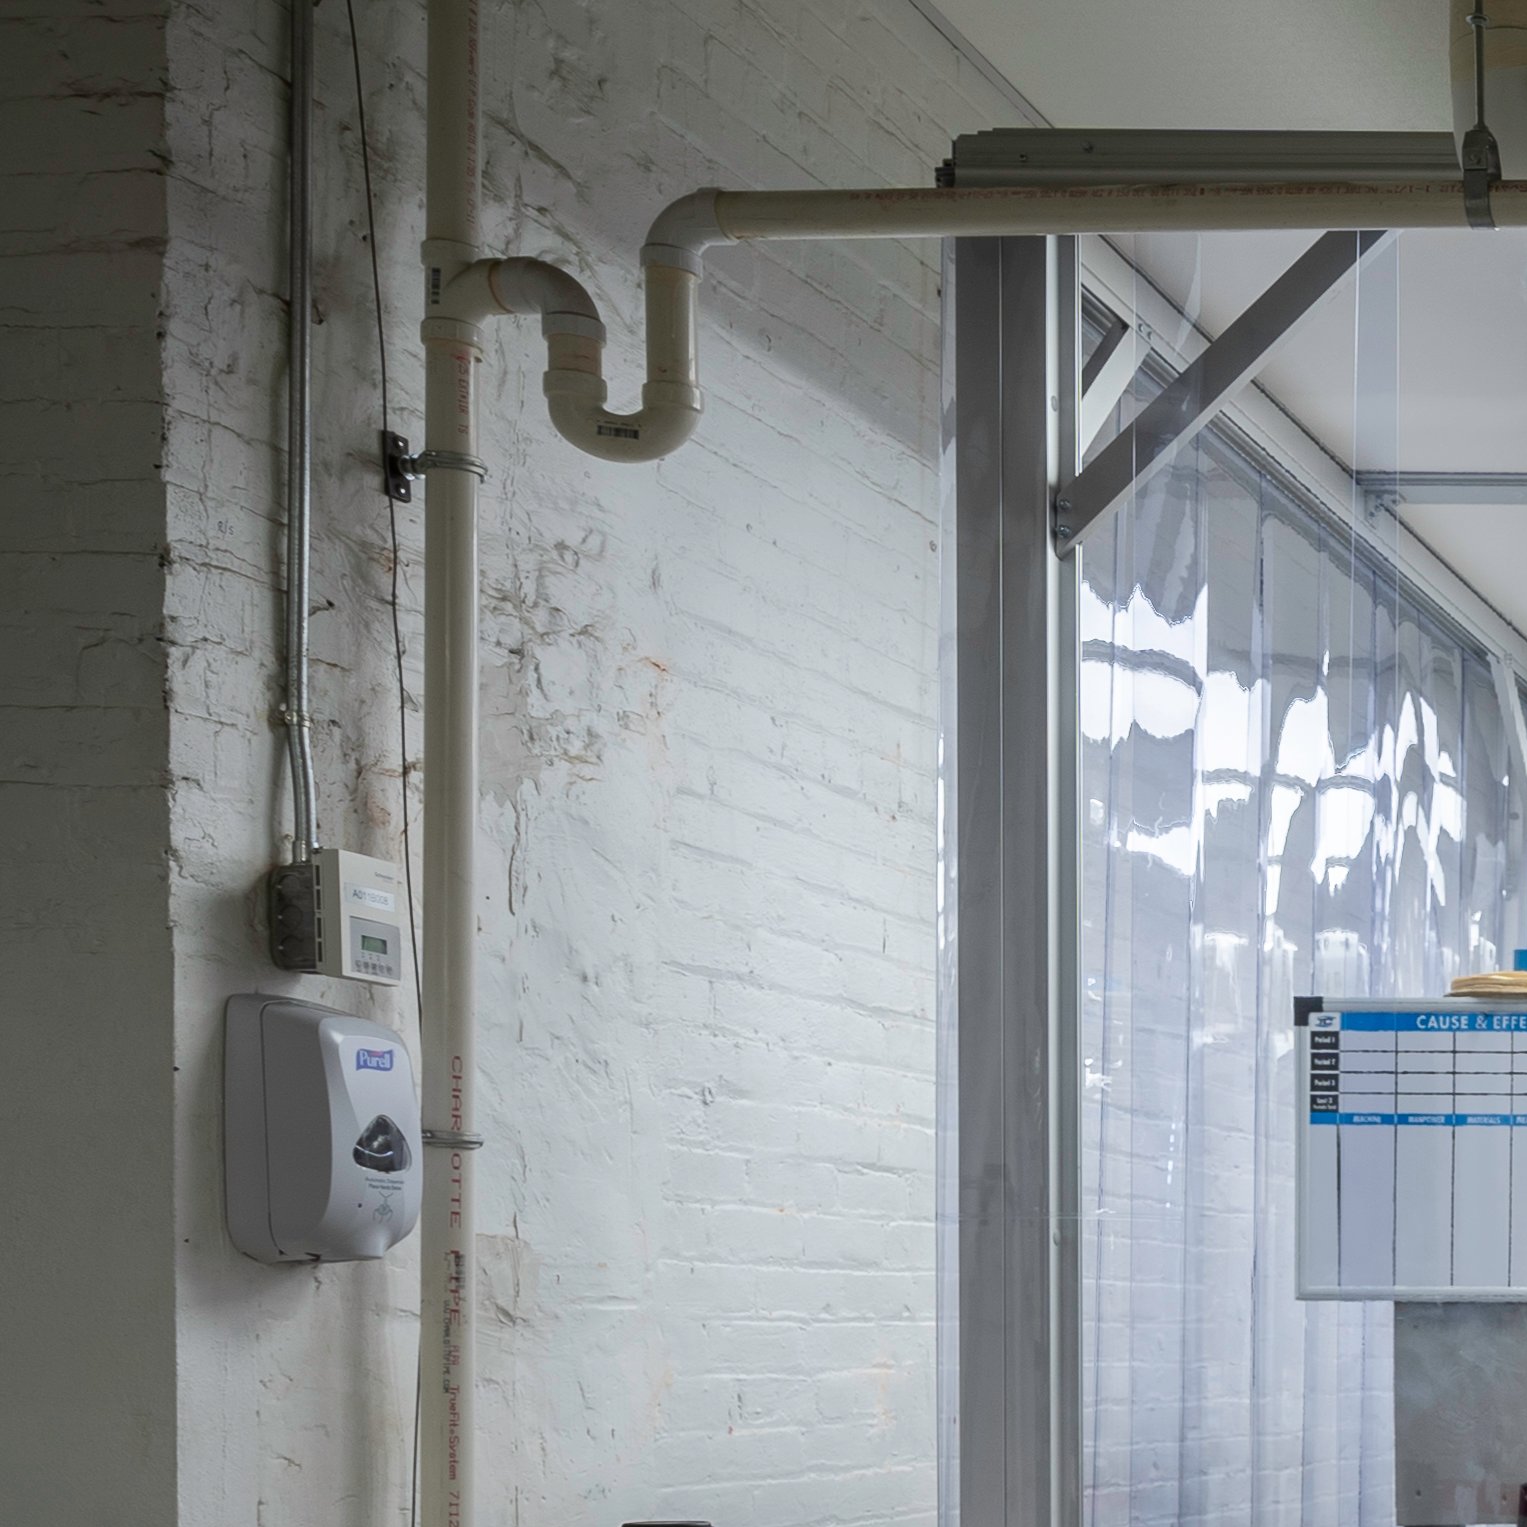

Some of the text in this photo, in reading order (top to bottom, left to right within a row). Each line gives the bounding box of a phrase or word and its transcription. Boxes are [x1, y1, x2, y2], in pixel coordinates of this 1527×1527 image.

[1416, 1015, 1469, 1029] CAUSE
[1475, 1015, 1488, 1029] &
[450, 1055, 463, 1229] CHAROTTE
